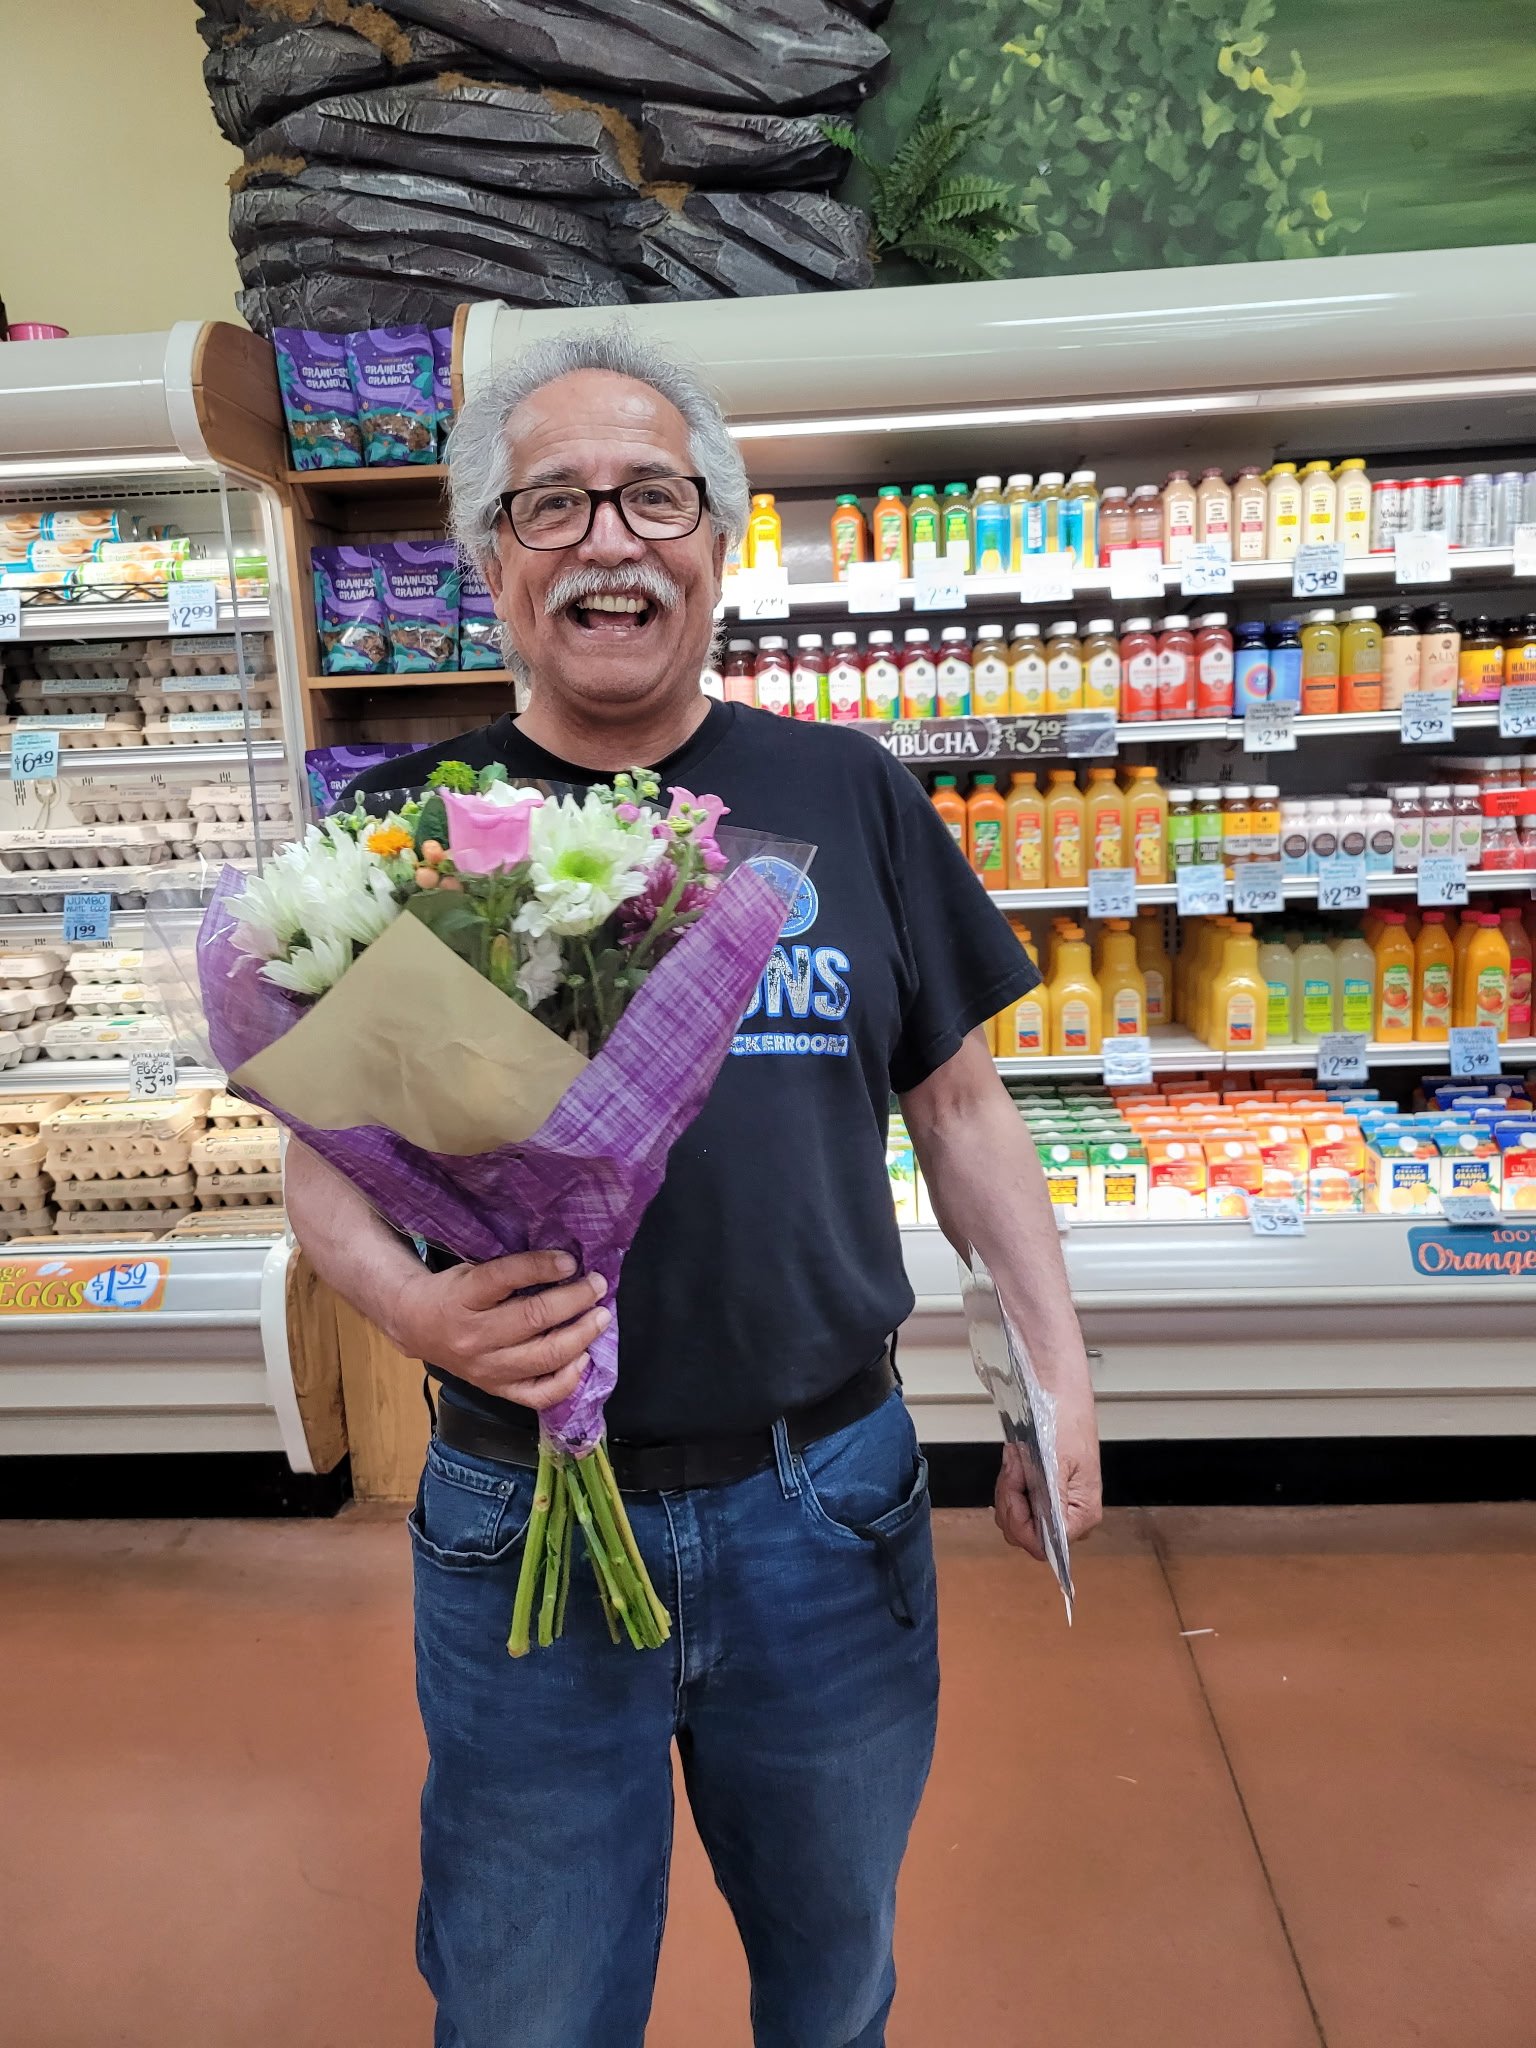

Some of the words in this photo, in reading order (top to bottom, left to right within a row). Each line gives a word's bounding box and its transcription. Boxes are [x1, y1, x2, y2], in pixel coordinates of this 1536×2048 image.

[364, 363, 415, 375] GRAINLESS
[306, 378, 349, 390] GRANOLA
[368, 374, 411, 386] GRANOLA
[391, 574, 439, 587] GRAINLESS
[339, 588, 375, 600] GRANOLA
[395, 586, 435, 598] GRANOLA
[879, 731, 980, 757] MBUCHA
[67, 896, 106, 905] JUMBO
[730, 1032, 850, 1057] CKERROOM
[137, 1066, 163, 1074] EGGS
[1492, 1230, 1536, 1243] 100
[1418, 1242, 1536, 1275] Orange
[0, 1280, 86, 1308] EGGS
